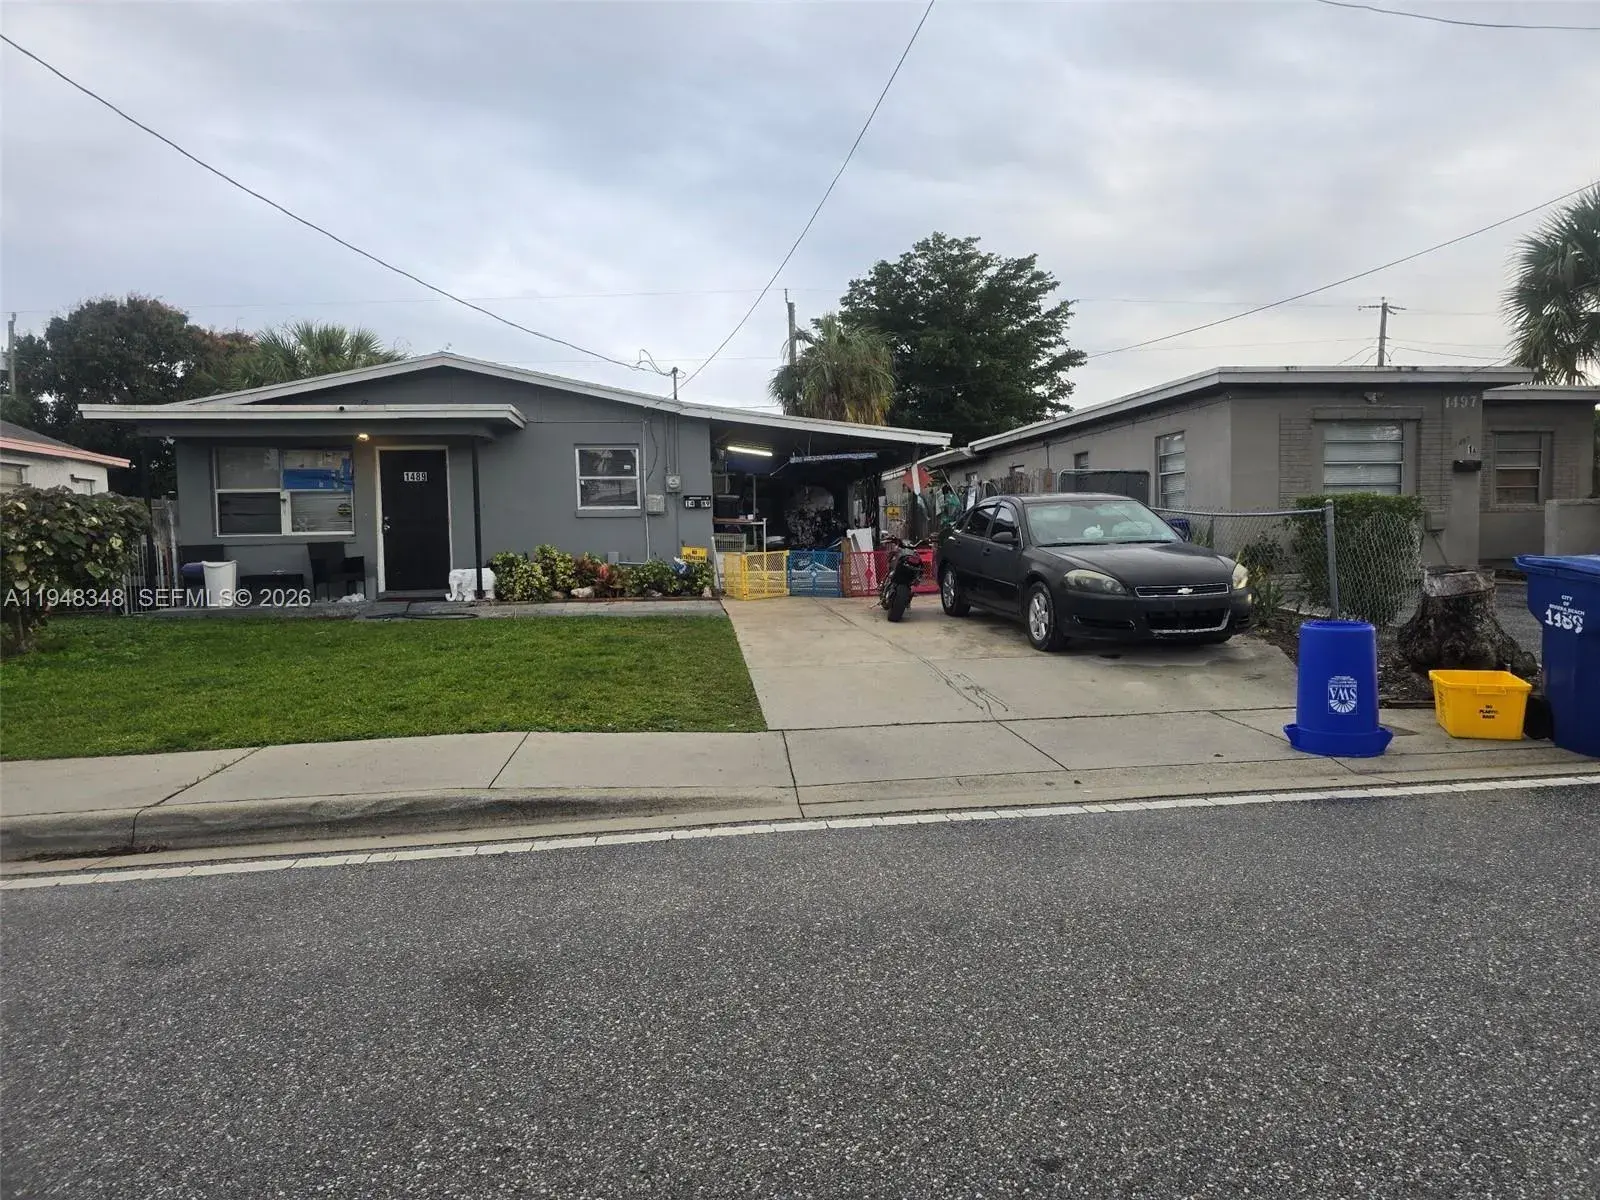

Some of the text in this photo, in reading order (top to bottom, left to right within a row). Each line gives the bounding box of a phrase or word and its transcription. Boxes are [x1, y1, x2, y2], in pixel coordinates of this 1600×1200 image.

[1445, 396, 1477, 408] 1497
[404, 472, 427, 481] 1489
[1329, 687, 1356, 701] SWA
